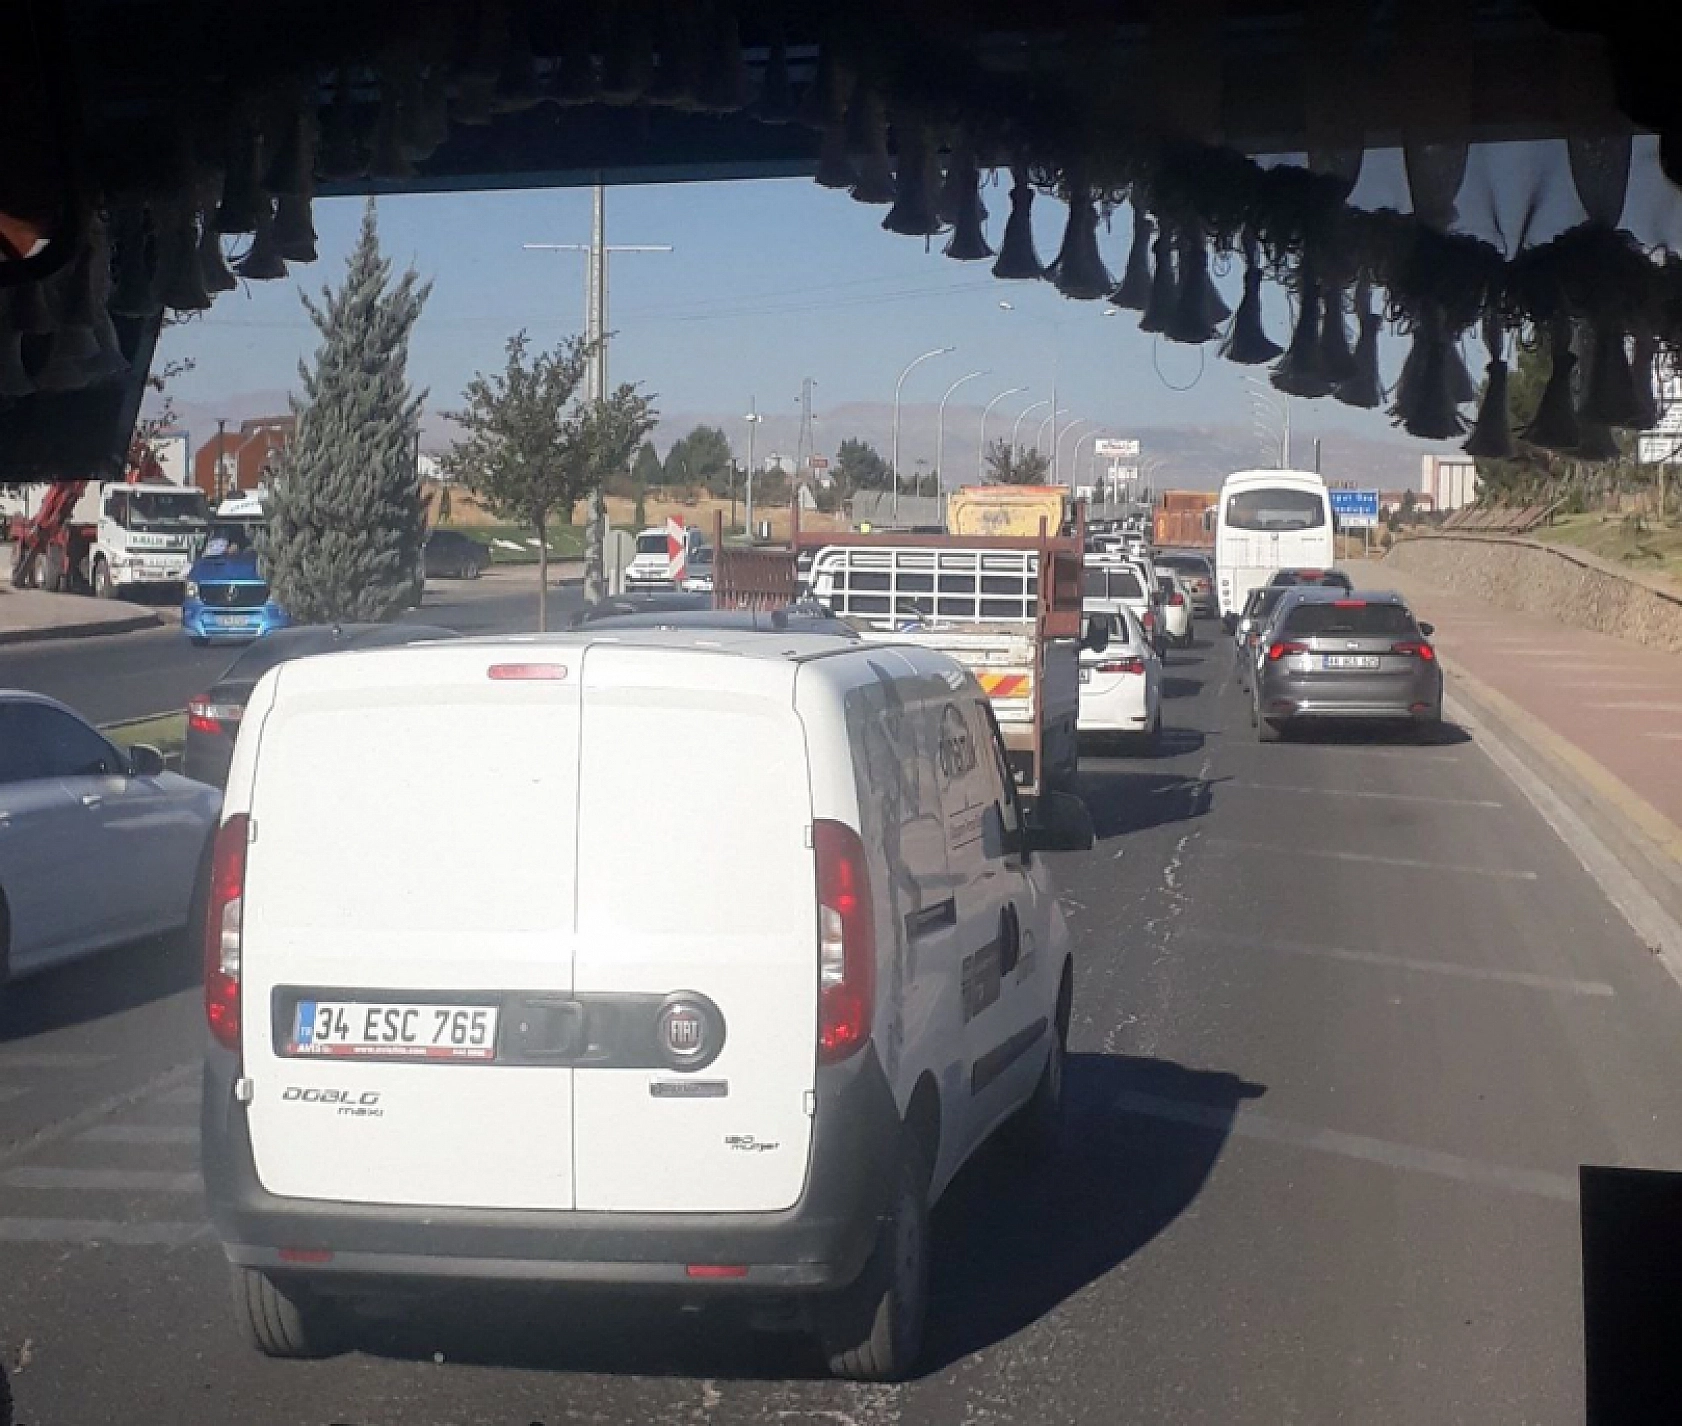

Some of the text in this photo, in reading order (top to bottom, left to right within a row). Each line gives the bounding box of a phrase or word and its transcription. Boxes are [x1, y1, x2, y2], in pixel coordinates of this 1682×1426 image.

[316, 1007, 487, 1044] 34 ESC 765
[671, 1020, 698, 1042] FIAT
